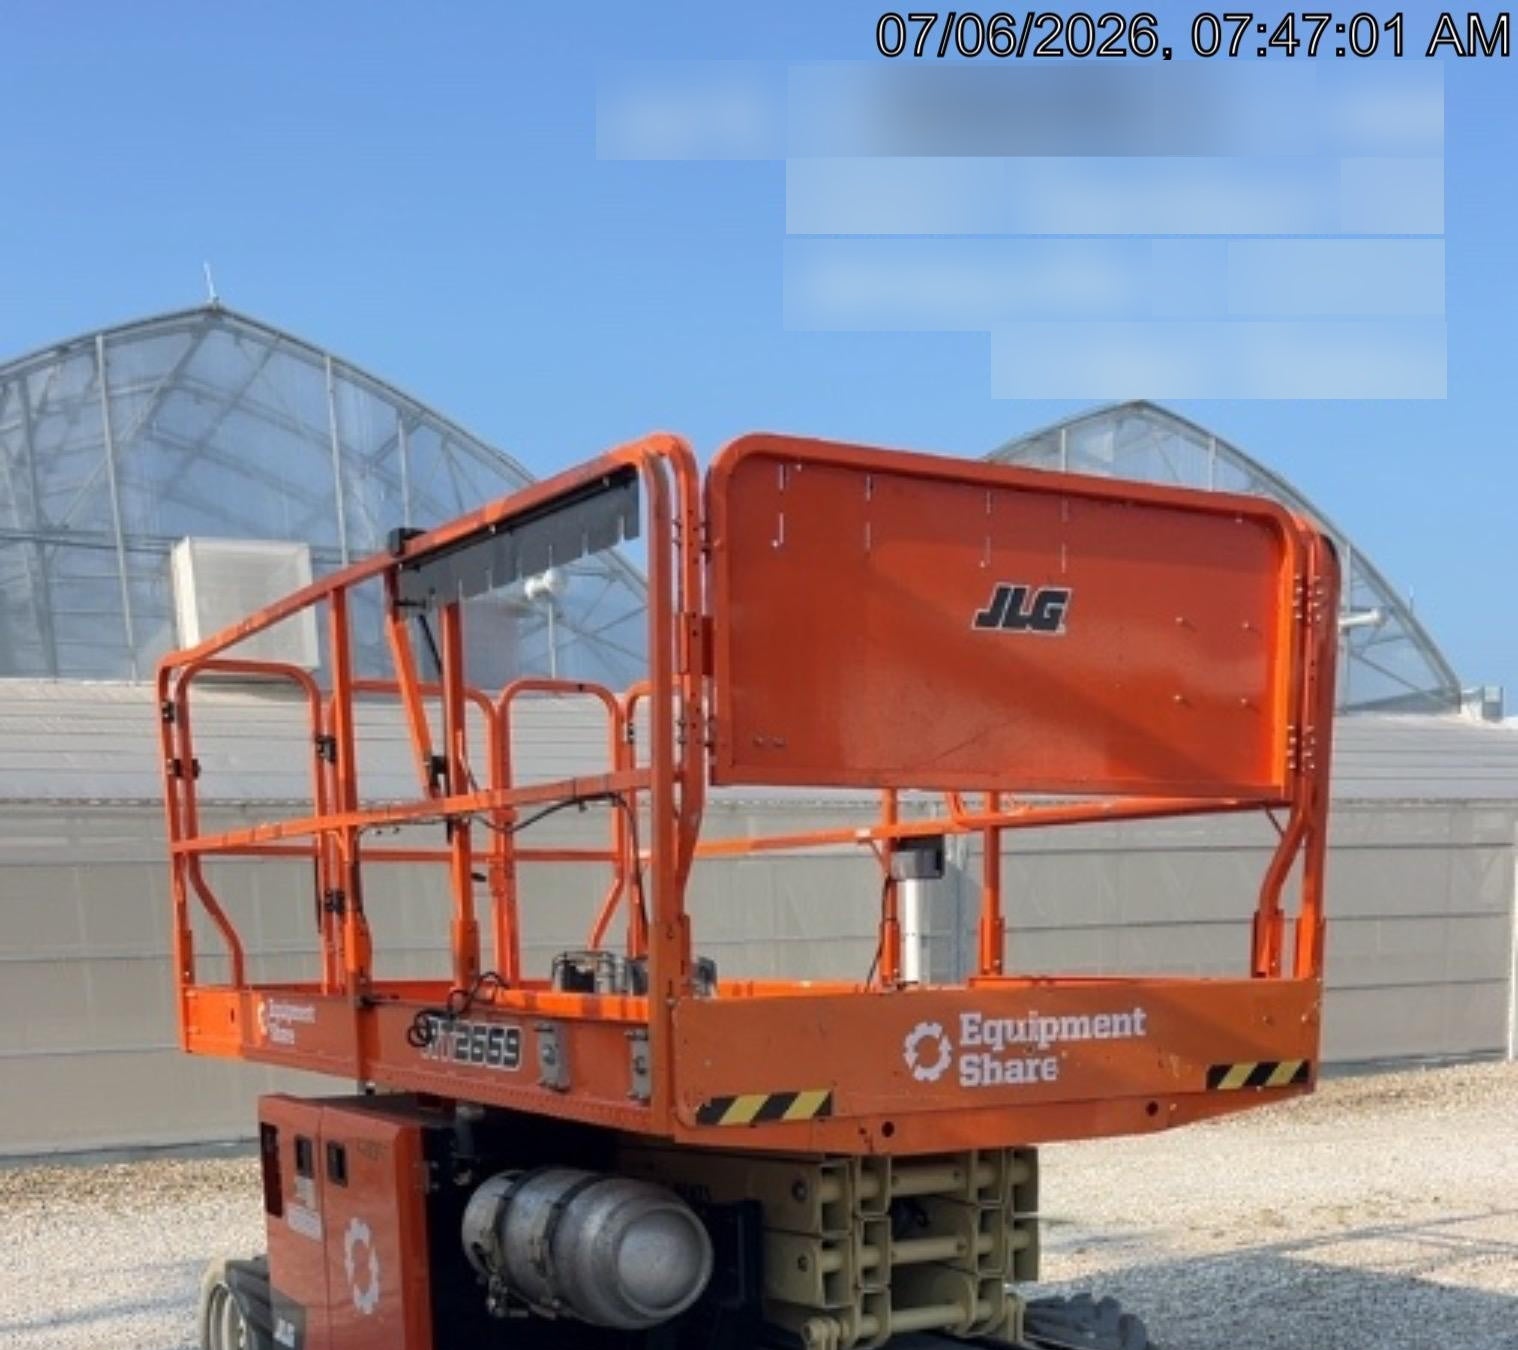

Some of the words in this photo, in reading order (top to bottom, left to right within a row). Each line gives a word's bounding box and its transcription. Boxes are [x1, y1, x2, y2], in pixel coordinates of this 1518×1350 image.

[971, 582, 1072, 634] JLG
[959, 1008, 1147, 1051] Equipment
[959, 1053, 1058, 1088] Share
